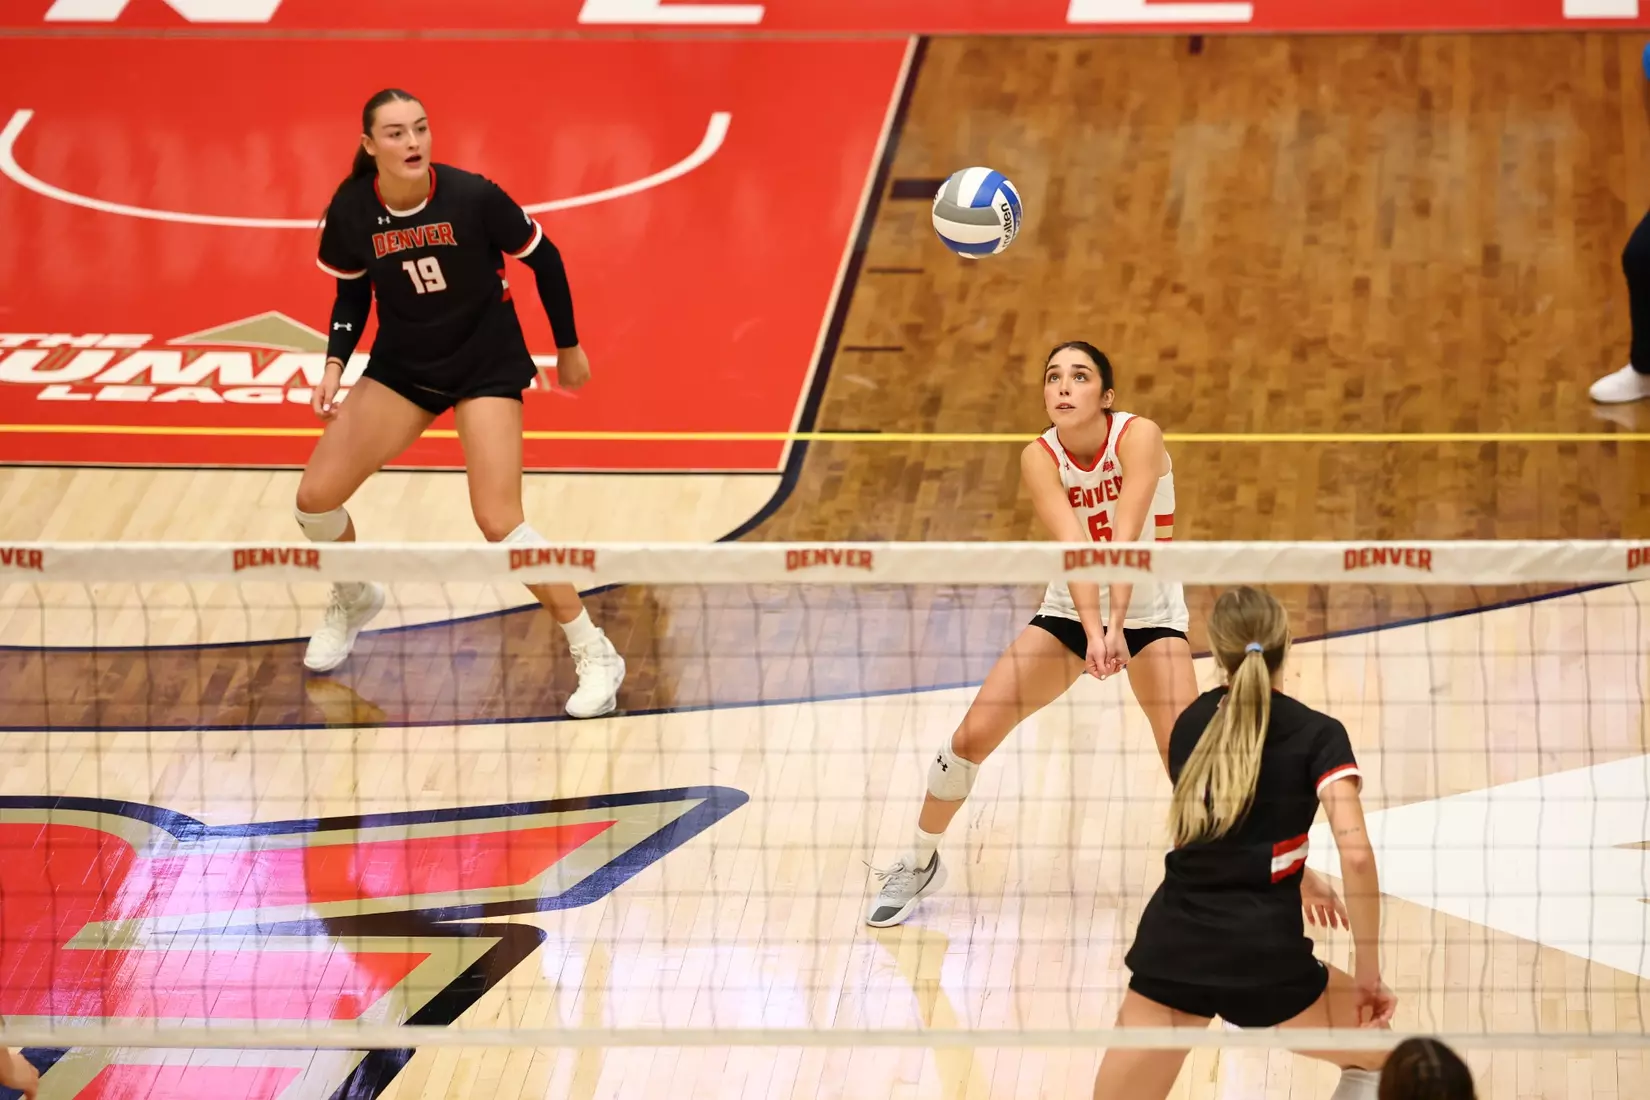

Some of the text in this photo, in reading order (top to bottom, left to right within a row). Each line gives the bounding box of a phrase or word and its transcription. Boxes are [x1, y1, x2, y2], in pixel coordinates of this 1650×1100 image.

[372, 221, 458, 260] DENVER
[402, 256, 447, 295] 19
[0, 333, 153, 349] THE
[232, 548, 319, 571] DENVER
[509, 548, 596, 571] DENVER
[785, 548, 873, 571] DENVER
[1063, 548, 1152, 571] DENVER
[1343, 547, 1432, 571] DENVER
